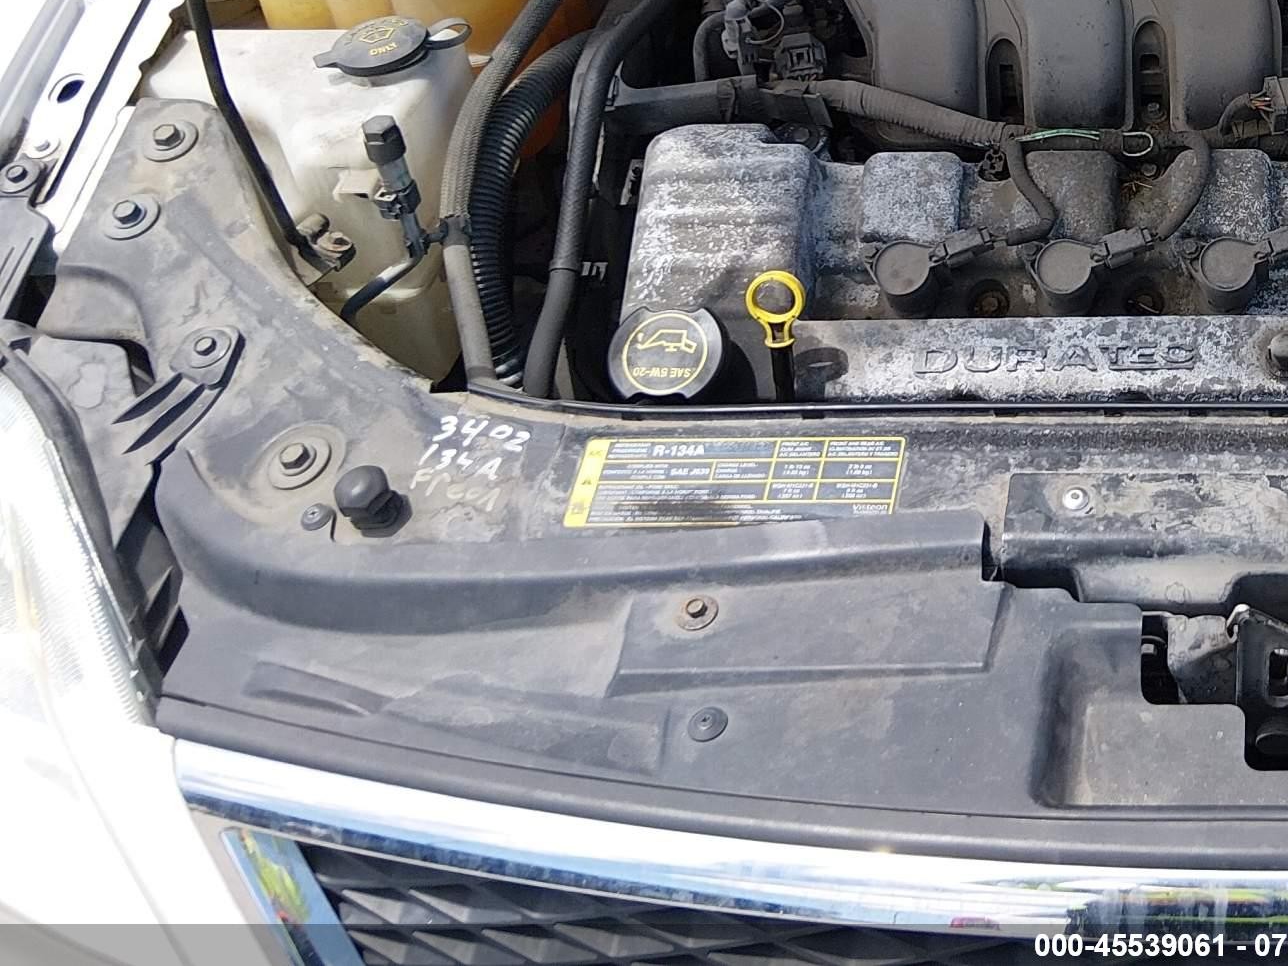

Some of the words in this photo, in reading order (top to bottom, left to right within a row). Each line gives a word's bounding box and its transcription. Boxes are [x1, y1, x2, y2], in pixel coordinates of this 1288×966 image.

[369, 42, 398, 57] ONLY
[912, 341, 1195, 375] DURATEC
[632, 366, 668, 378] 5W-20
[669, 367, 692, 378] SAE
[431, 414, 531, 453] 3402
[652, 444, 705, 457] R-134A
[418, 443, 502, 481] 134A
[670, 468, 689, 476] SAE
[852, 503, 888, 511] Visteon
